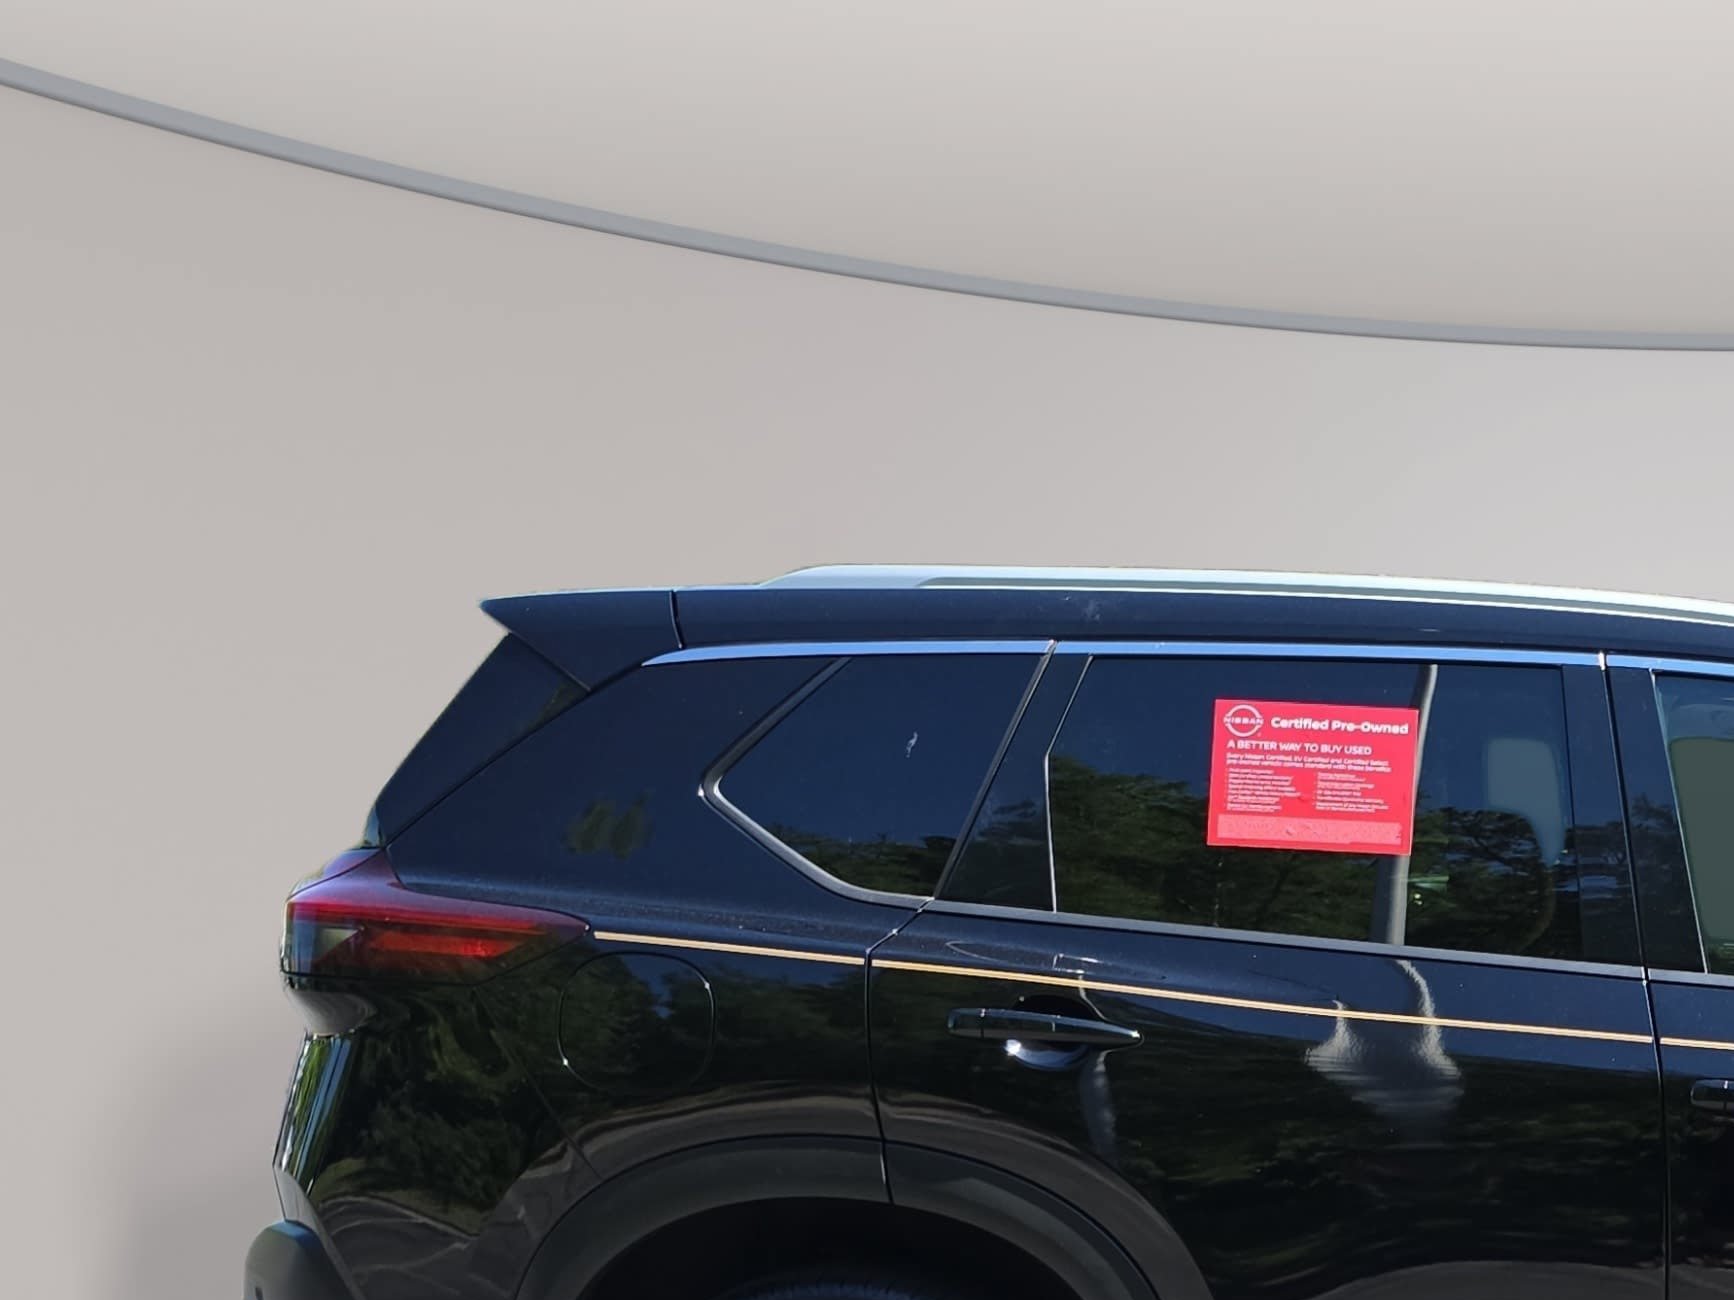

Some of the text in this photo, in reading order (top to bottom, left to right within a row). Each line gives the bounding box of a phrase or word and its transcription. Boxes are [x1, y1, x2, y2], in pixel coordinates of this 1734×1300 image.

[1224, 716, 1264, 725] NISSAN
[1271, 716, 1409, 734] Certified Pre-Owned
[1227, 741, 1372, 755] A BETTER WAY TO BUY USED
